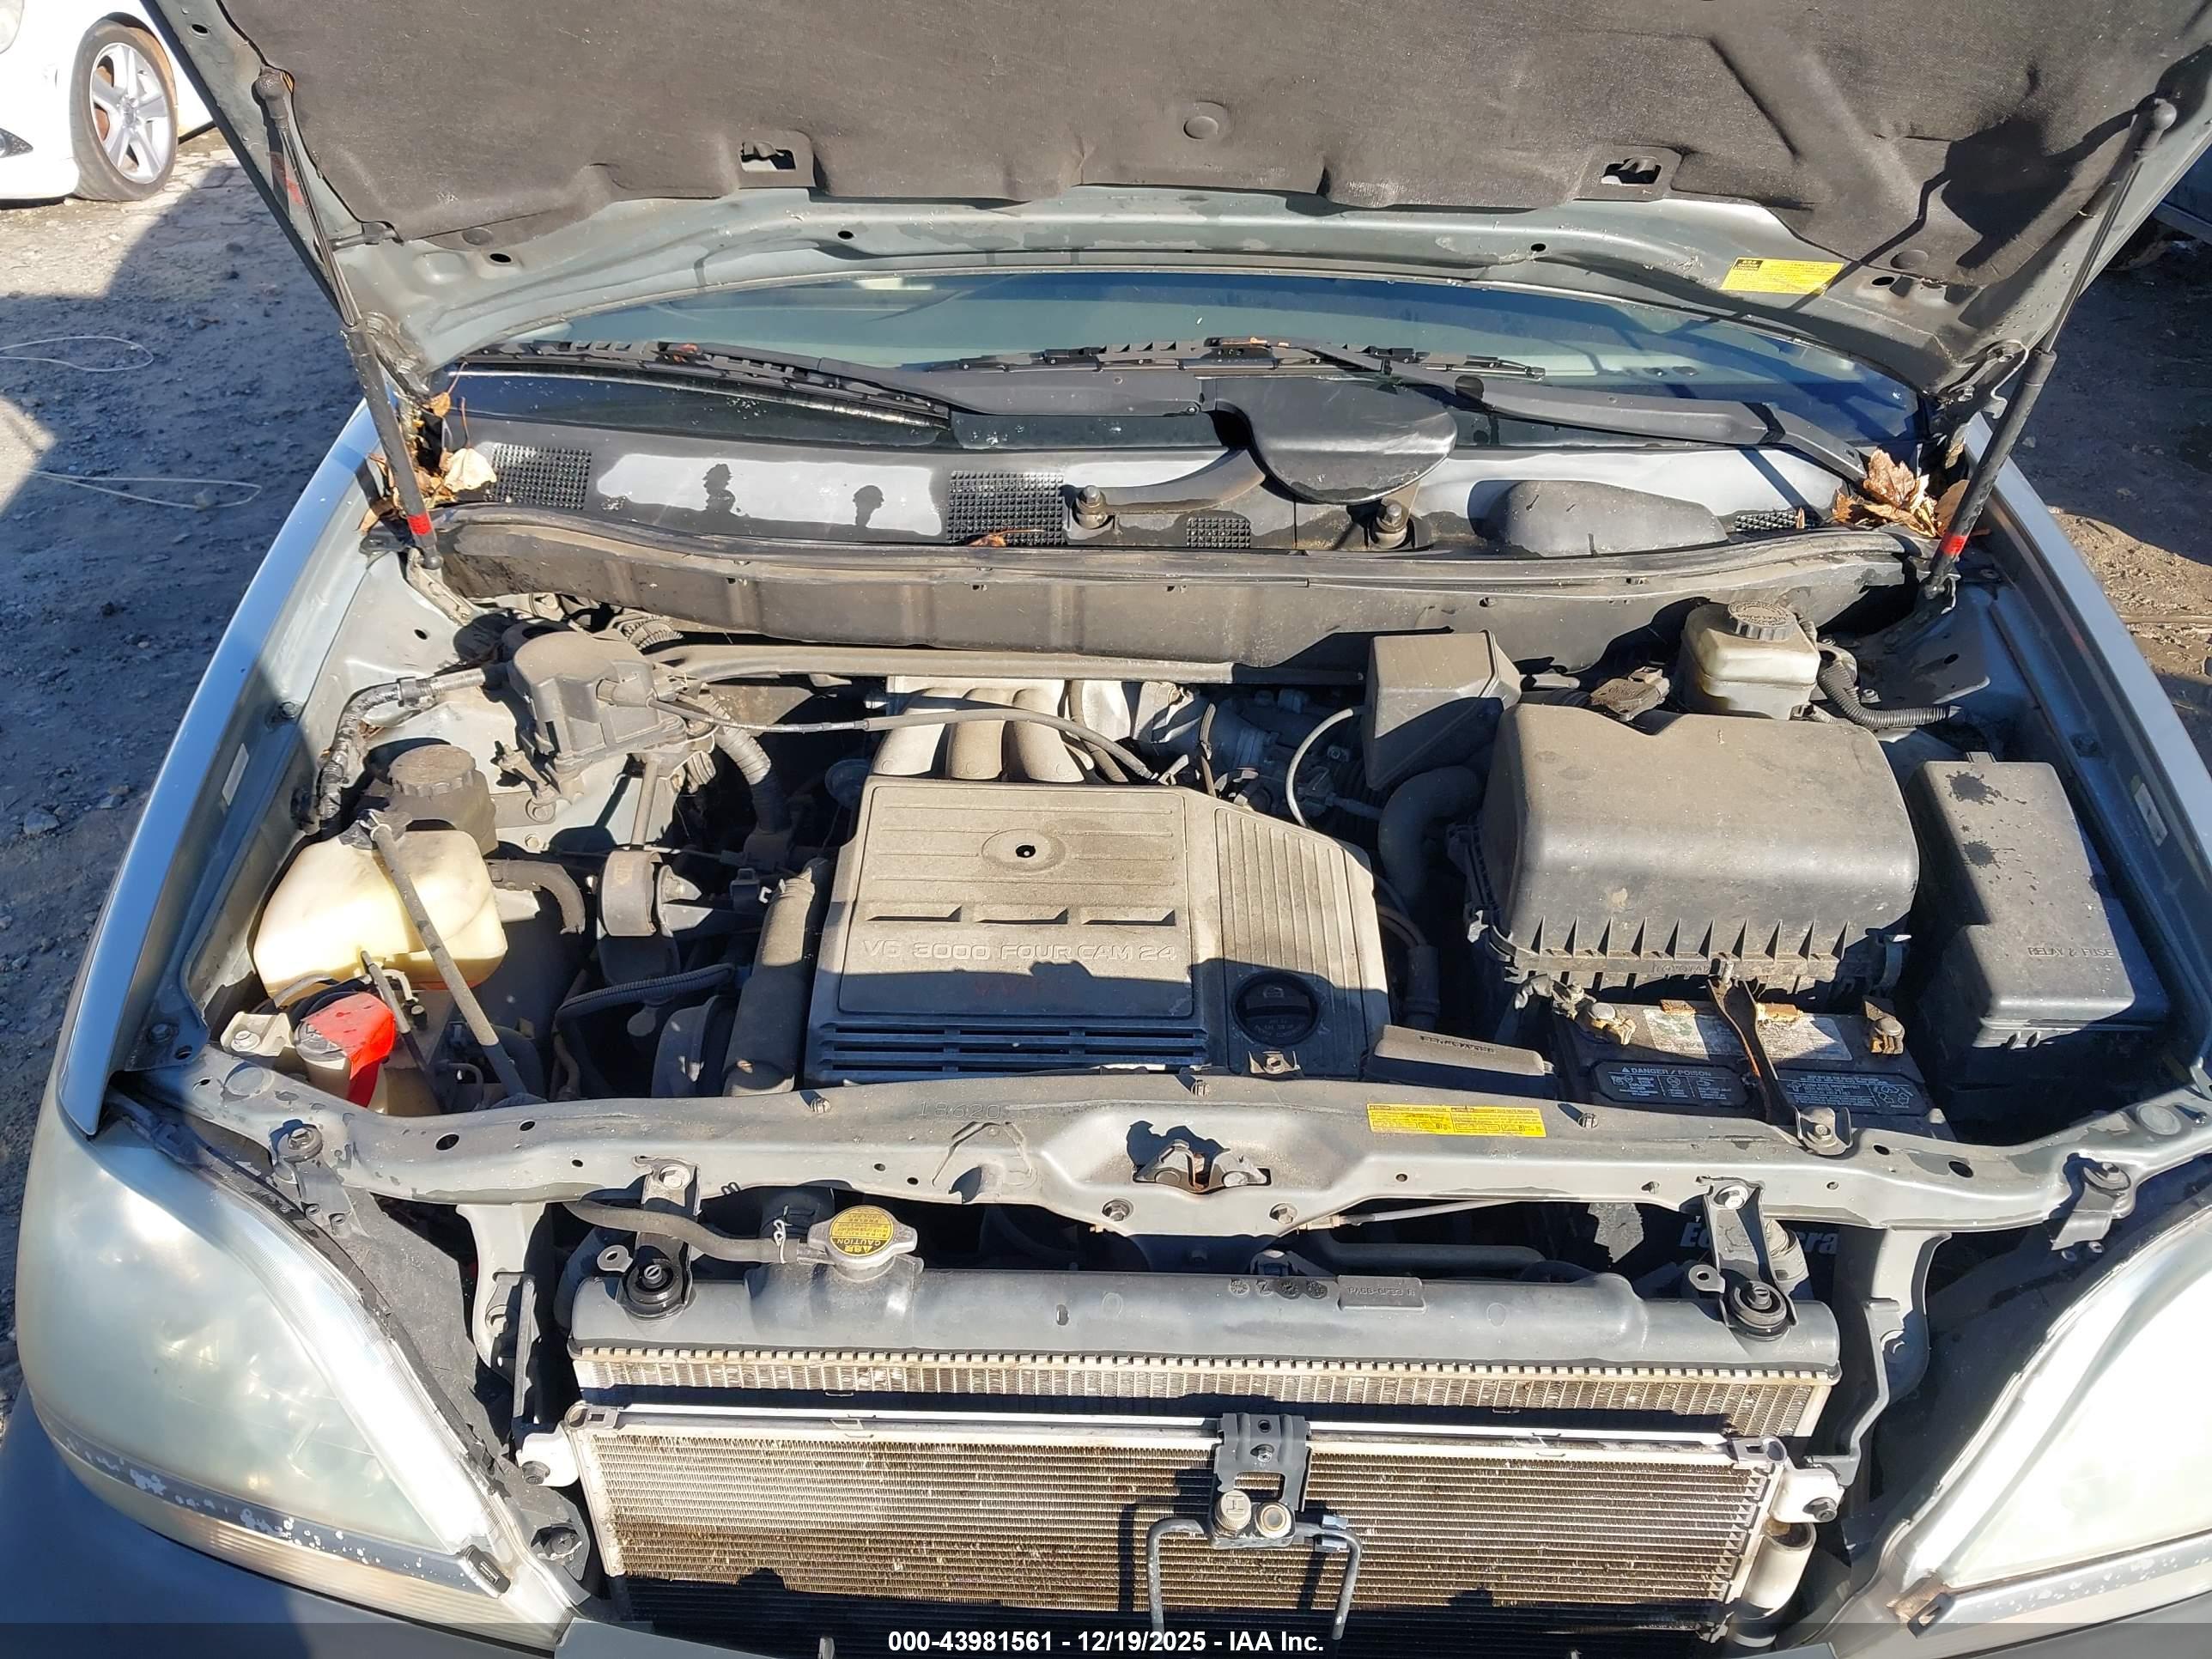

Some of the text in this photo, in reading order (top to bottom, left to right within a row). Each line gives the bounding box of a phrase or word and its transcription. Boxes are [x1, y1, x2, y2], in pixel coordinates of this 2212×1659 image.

[862, 939, 1178, 962] V6 3000 FOUR CAM 24
[2026, 946, 2115, 957] RELAY & FUSE
[917, 1101, 1000, 1120] 18620
[836, 1238, 881, 1247] CAUTION
